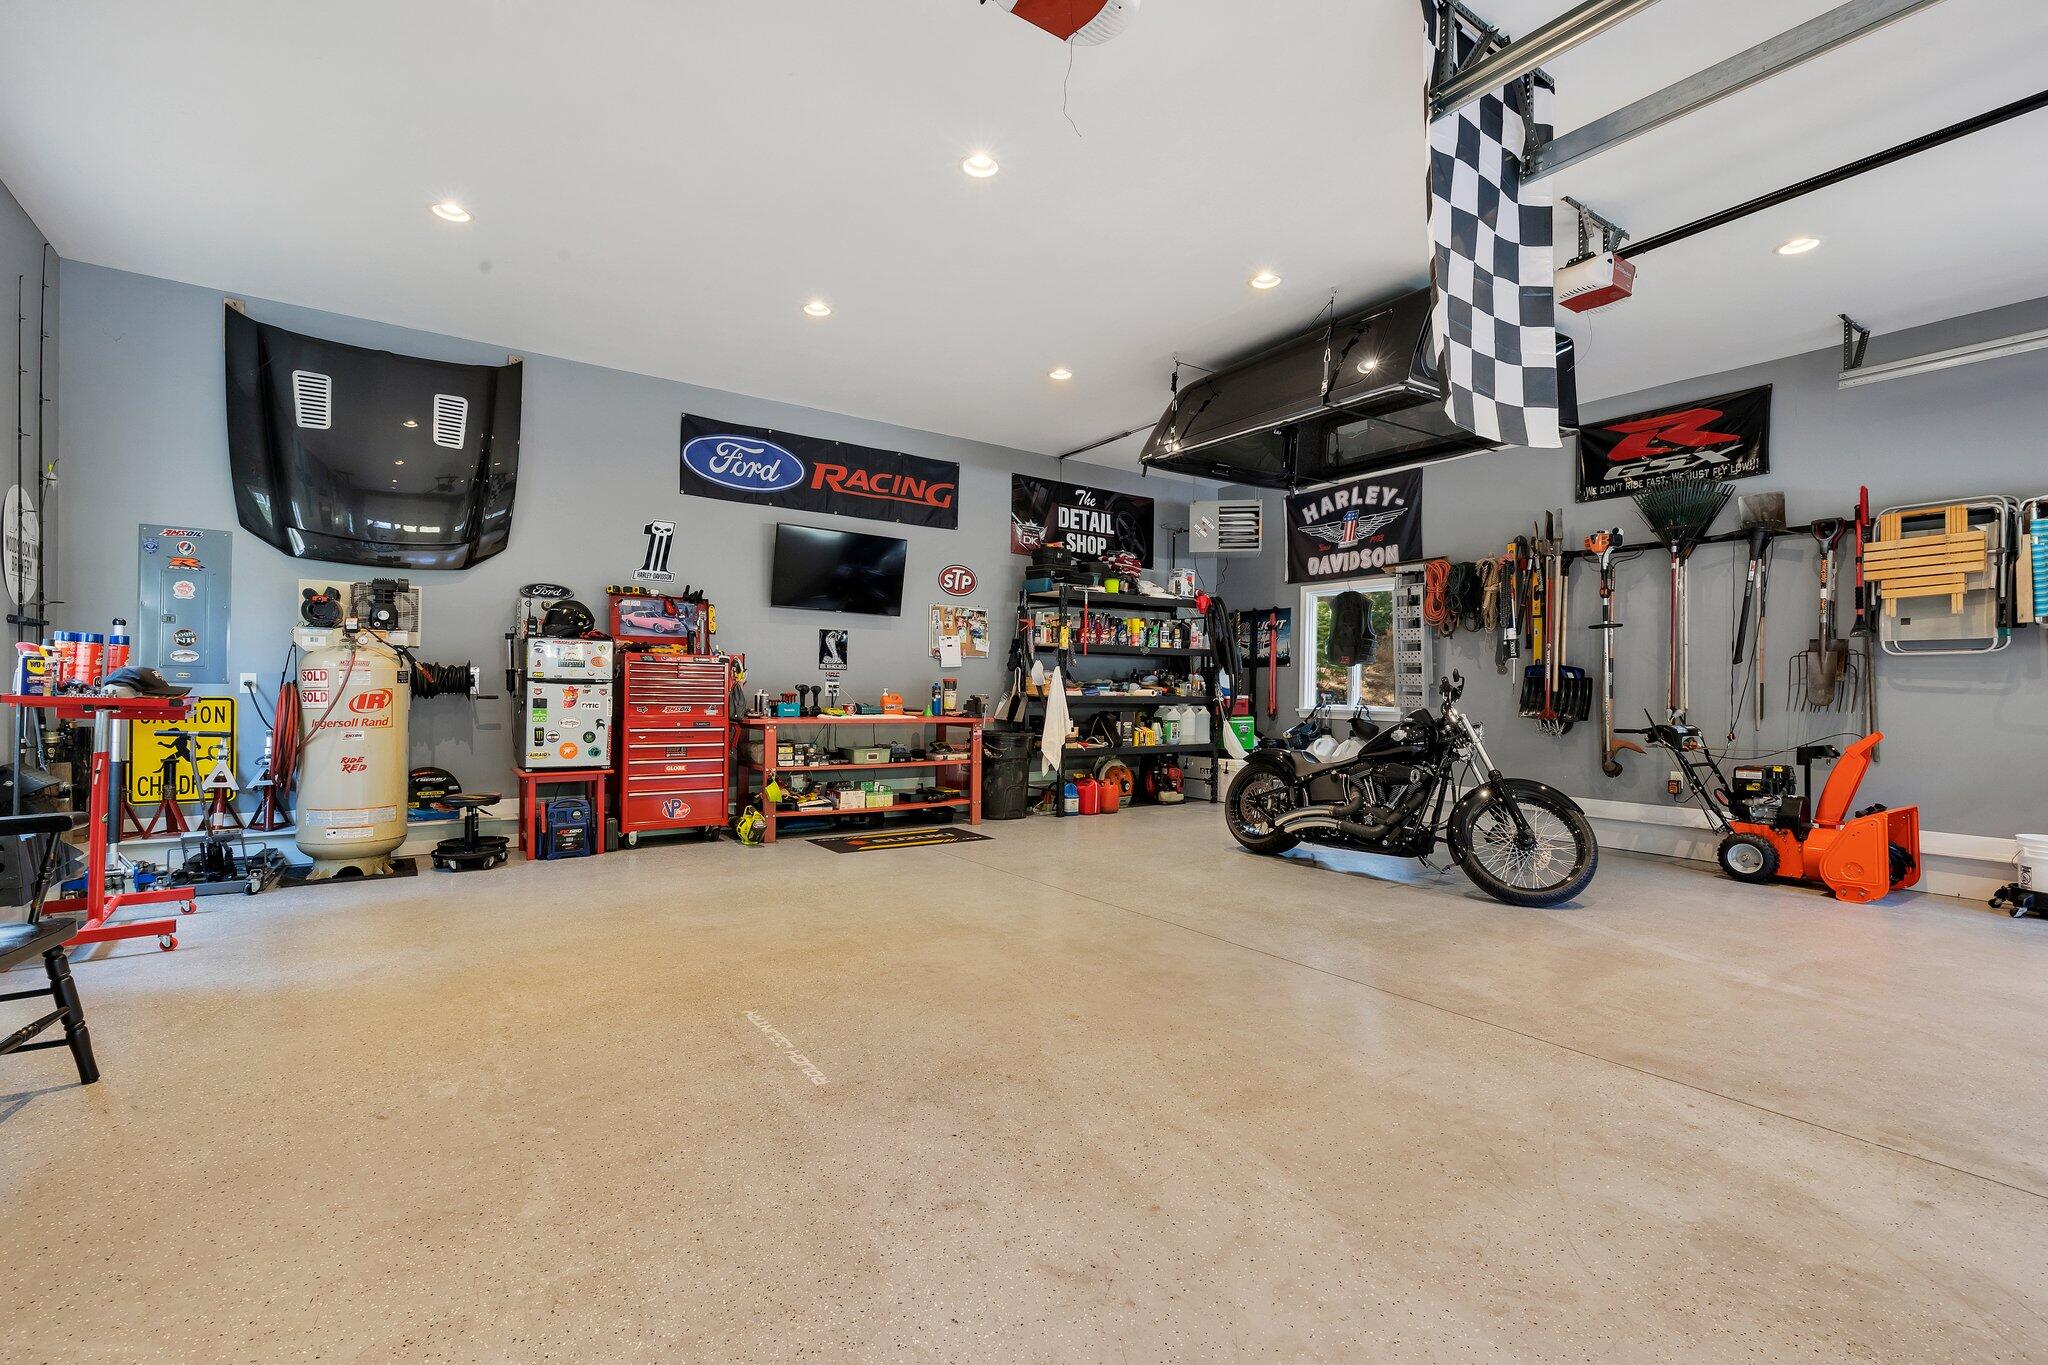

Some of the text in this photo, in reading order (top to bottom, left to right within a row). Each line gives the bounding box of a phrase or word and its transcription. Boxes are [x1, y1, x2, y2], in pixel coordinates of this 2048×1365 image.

[708, 442, 955, 509] Ford RACING
[1600, 482, 1622, 495] DON'T
[1625, 479, 1643, 491] RIDE
[1687, 468, 1710, 481] JUST
[1713, 463, 1728, 477] FLY
[1075, 489, 1097, 507] The
[1302, 485, 1405, 525] HARLEY-
[1058, 506, 1115, 535] DETAIL
[163, 528, 205, 538] AMSOIL
[1023, 535, 1040, 547] DK
[1066, 533, 1107, 556] SHOP
[1307, 544, 1400, 576] DAVIDSON
[943, 569, 972, 591] STP
[532, 584, 562, 597] Ford
[302, 670, 328, 682] SOLD
[302, 692, 328, 703] SOLD
[356, 693, 386, 710] IR
[311, 717, 389, 730] Ingersoll Rand
[341, 756, 365, 764] RIDE
[342, 763, 368, 774] RED
